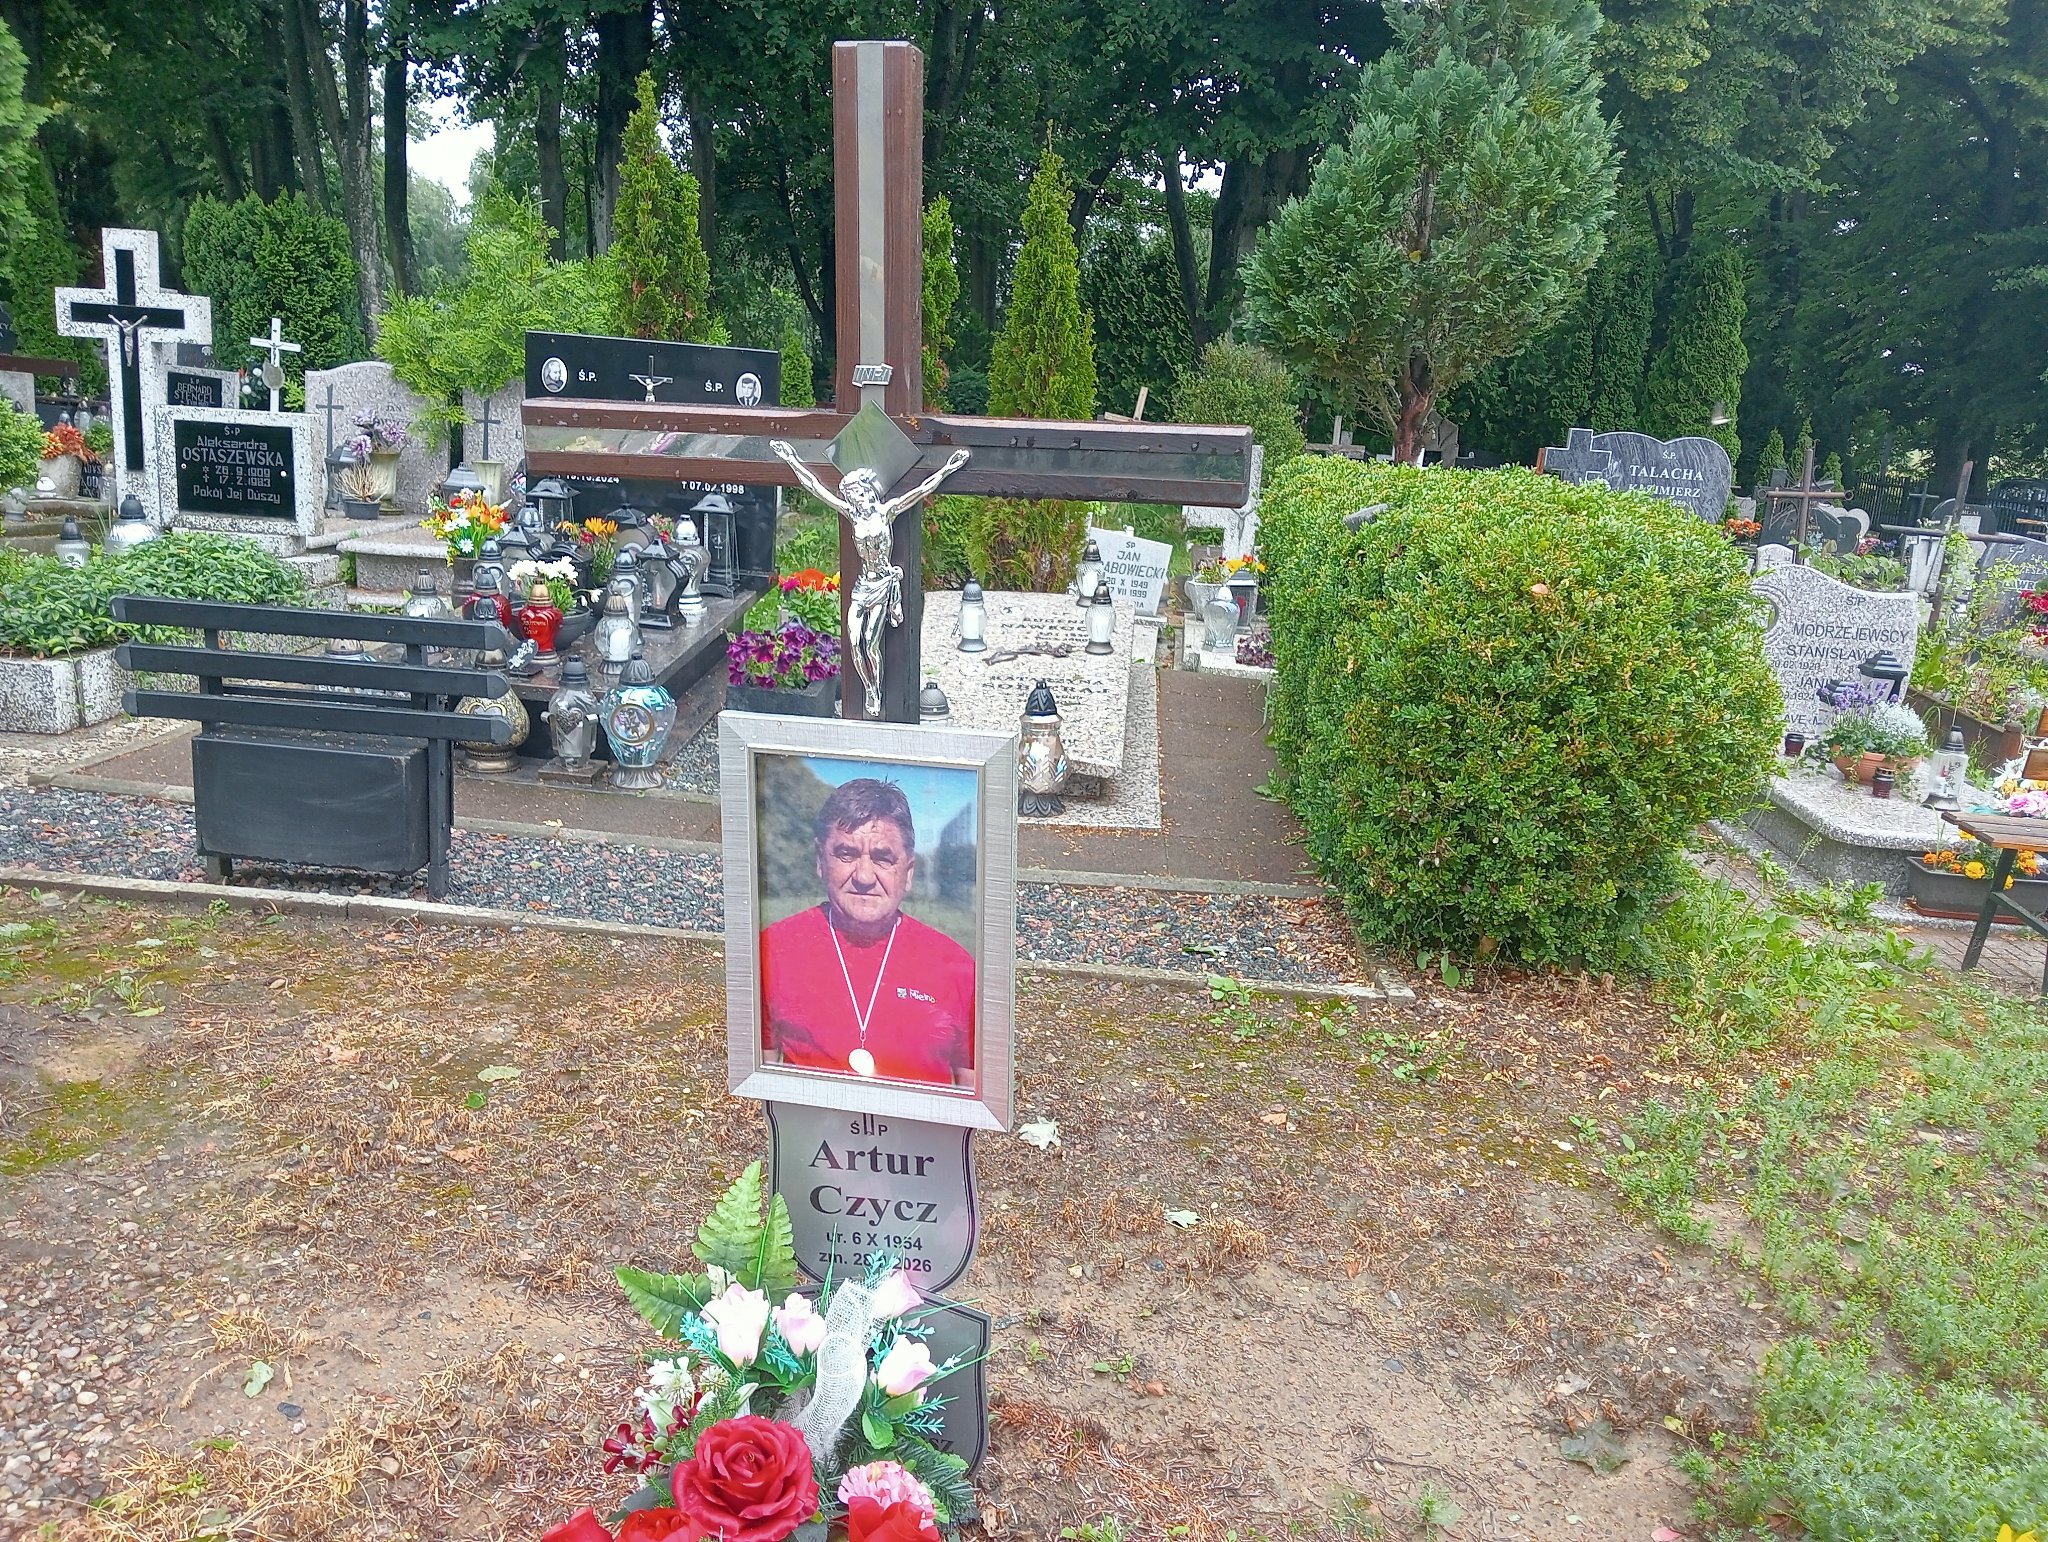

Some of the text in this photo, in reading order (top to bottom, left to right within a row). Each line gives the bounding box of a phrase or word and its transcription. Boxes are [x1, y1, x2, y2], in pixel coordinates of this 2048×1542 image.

[578, 369, 597, 382] Ś.P.
[705, 380, 724, 393] Ś.P.
[196, 435, 268, 451] Aleksandra
[182, 446, 284, 467] OSTASZEWSKA
[1629, 465, 1704, 481] TALACHA
[193, 484, 222, 500] Pokój
[226, 487, 242, 501] Jej
[1117, 551, 1141, 562] JAN
[1131, 580, 1149, 589] 1949
[1117, 588, 1127, 596] VII
[1793, 623, 1910, 644] MODRZEJEWSCY
[1796, 677, 1831, 689] JANI
[878, 1124, 888, 1136] P
[808, 1139, 935, 1177] Artur
[809, 1185, 938, 1227] Czycz
[826, 1231, 923, 1250] ur. 6 X 1954
[818, 1252, 848, 1265] zm.
